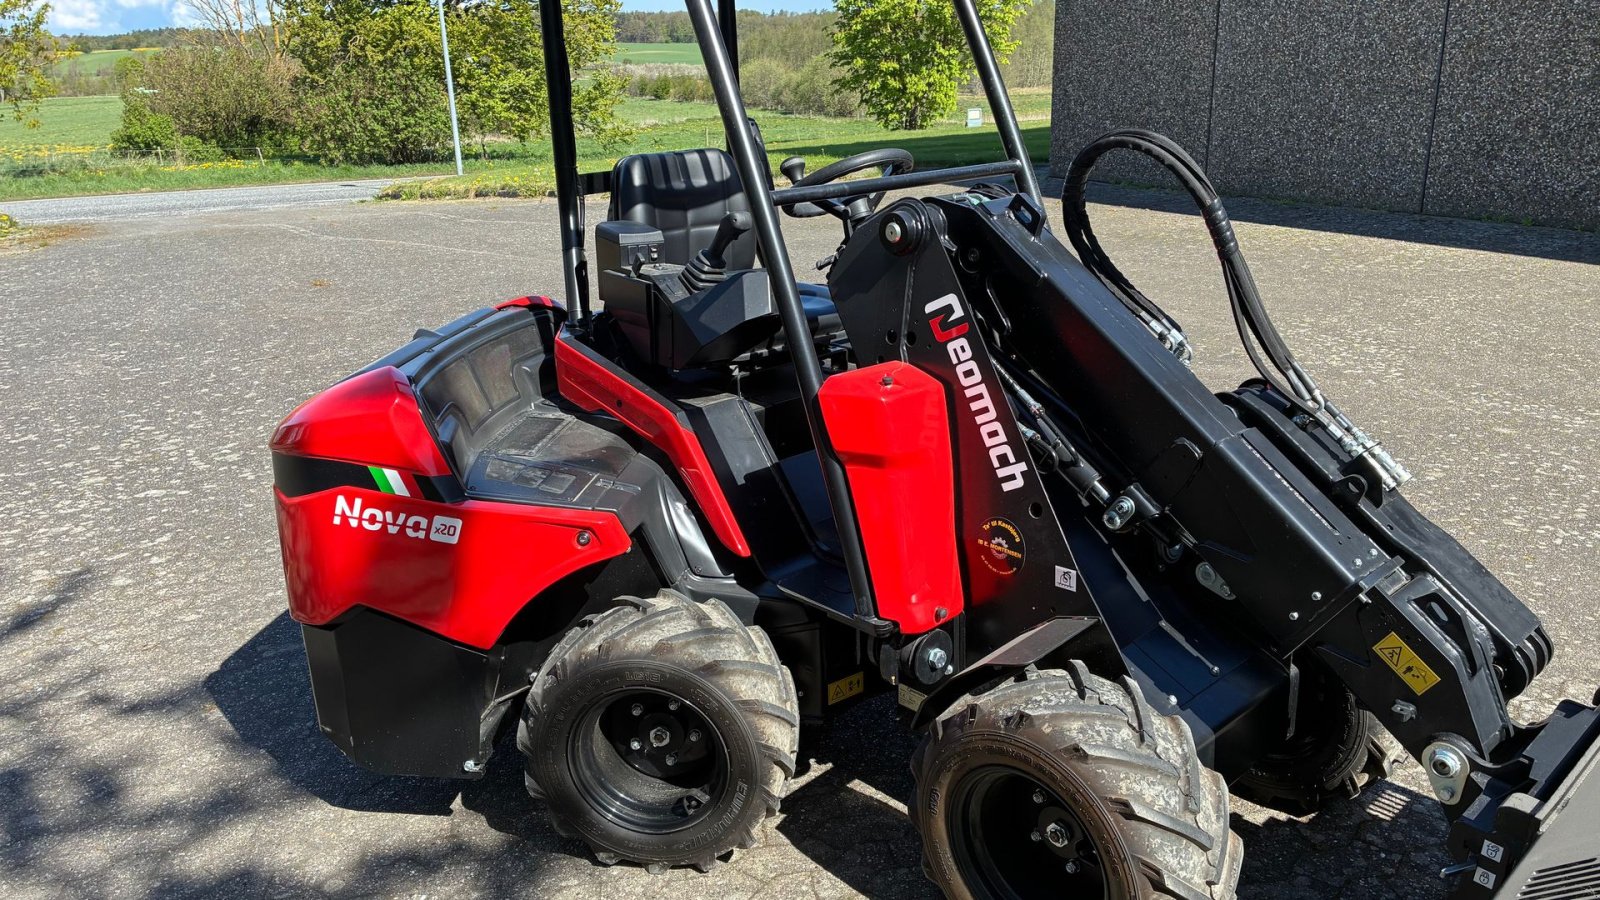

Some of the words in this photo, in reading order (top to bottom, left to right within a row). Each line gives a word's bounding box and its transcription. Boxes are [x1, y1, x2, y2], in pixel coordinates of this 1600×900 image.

[925, 293, 1029, 492] Neomach
[333, 495, 428, 539] Nova
[434, 523, 457, 537] x20
[990, 543, 1022, 559] MORTENSEN
